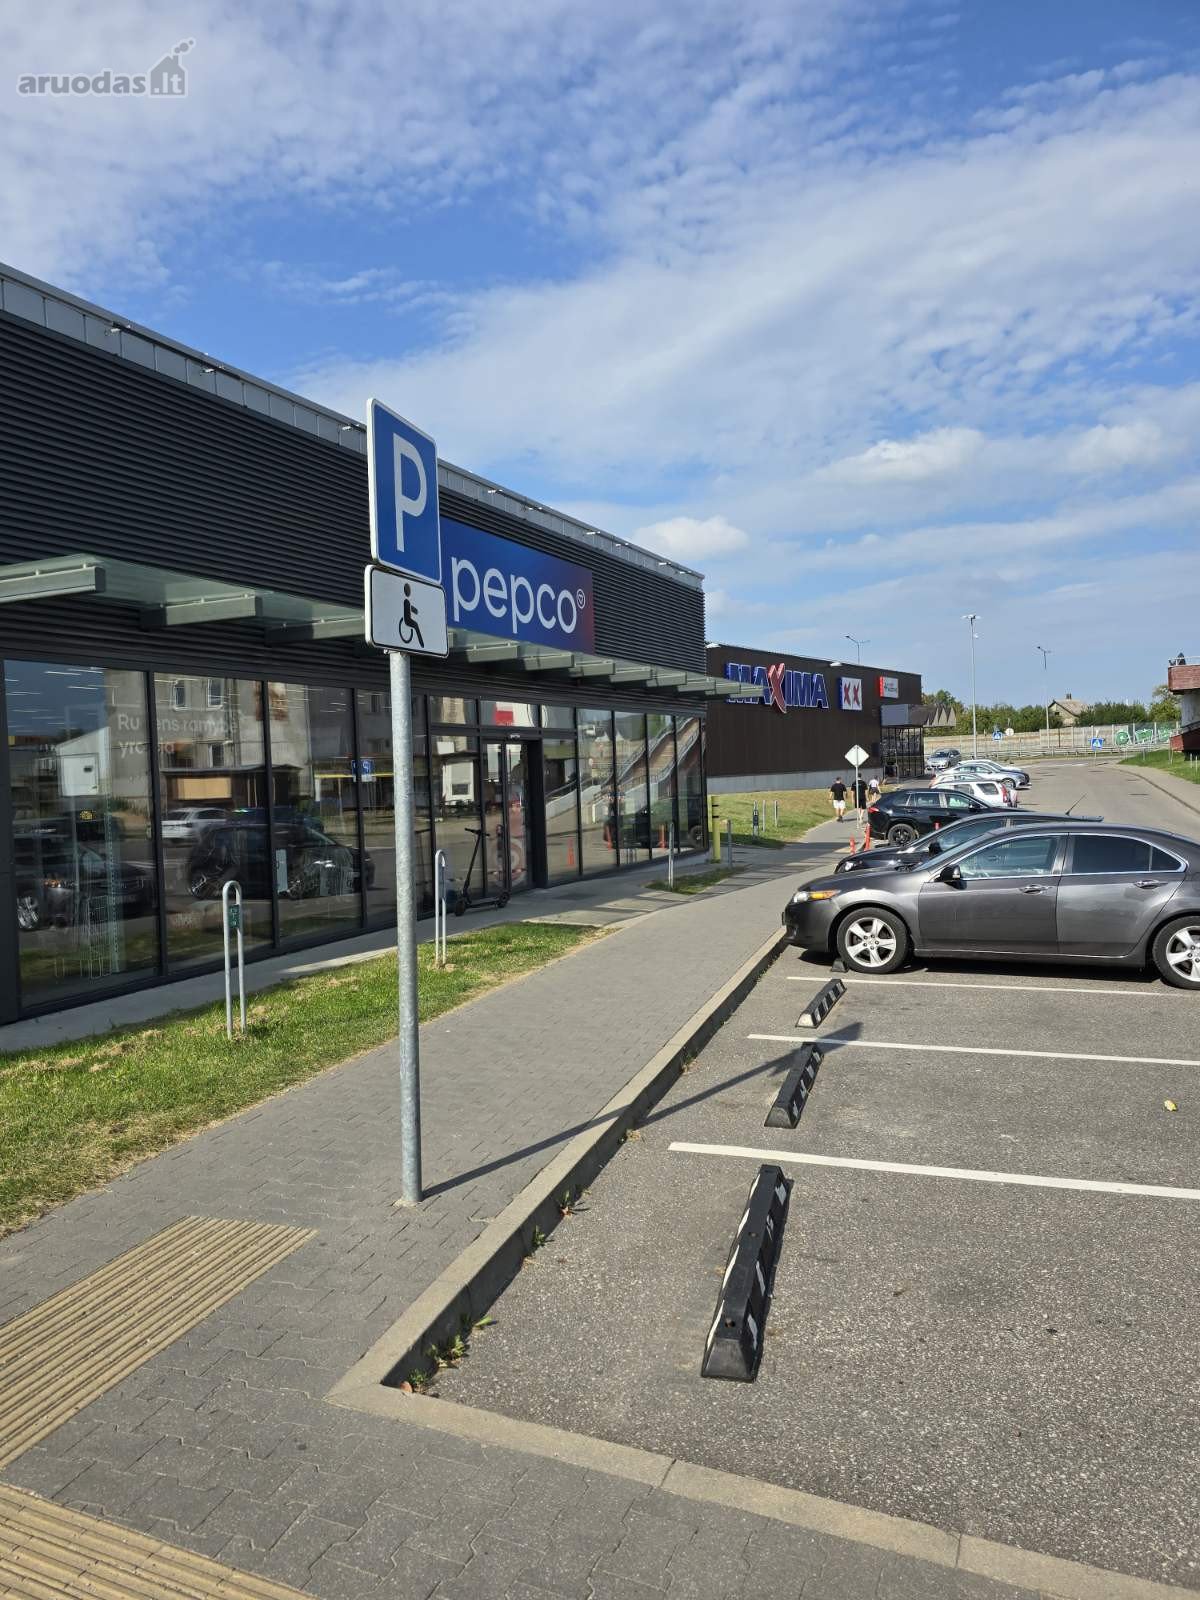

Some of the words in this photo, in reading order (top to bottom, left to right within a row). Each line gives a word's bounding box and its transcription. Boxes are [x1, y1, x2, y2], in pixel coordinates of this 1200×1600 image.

[393, 432, 427, 552] P
[451, 556, 577, 633] pepco
[118, 714, 179, 731] Ruens
